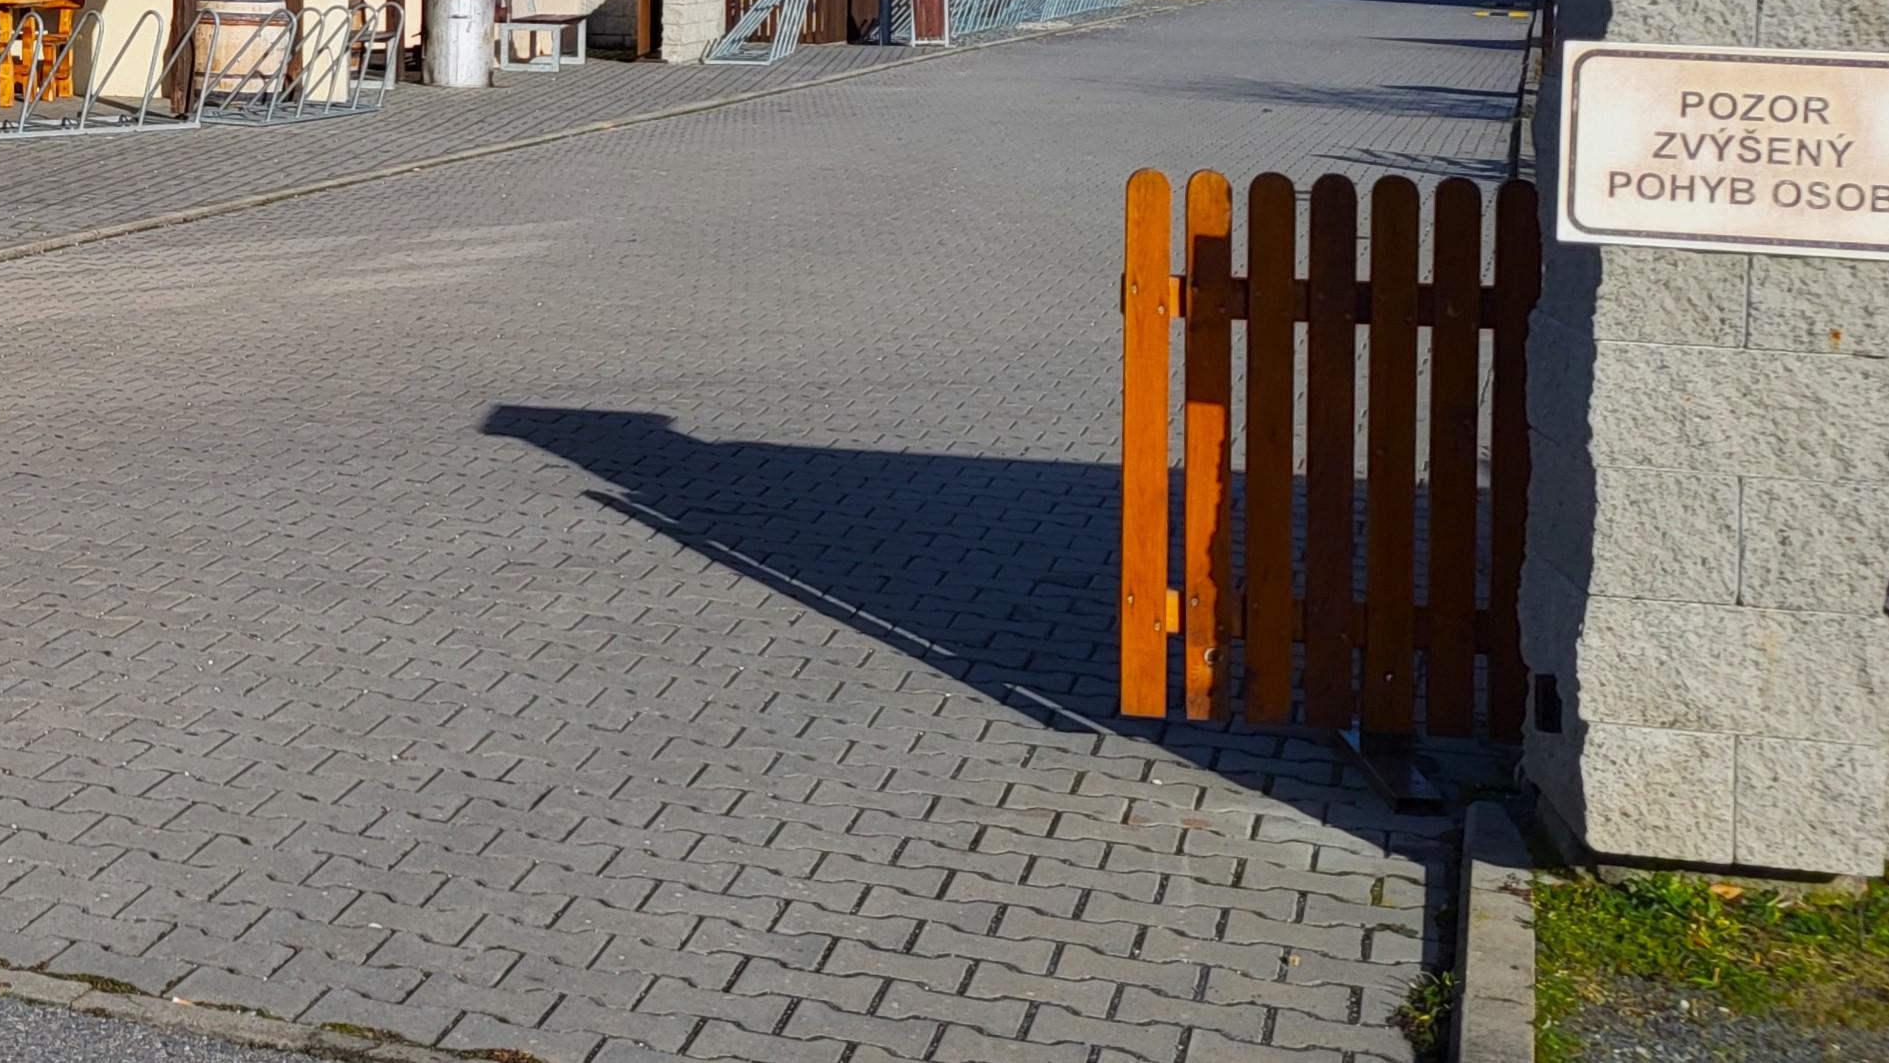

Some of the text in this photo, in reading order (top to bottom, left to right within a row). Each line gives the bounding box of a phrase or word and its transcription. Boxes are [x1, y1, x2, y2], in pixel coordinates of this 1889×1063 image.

[1680, 91, 1830, 124] POZOR
[1652, 128, 1854, 168] ZVÝŠENÝ
[1608, 170, 1889, 213] POHYB OSOB
